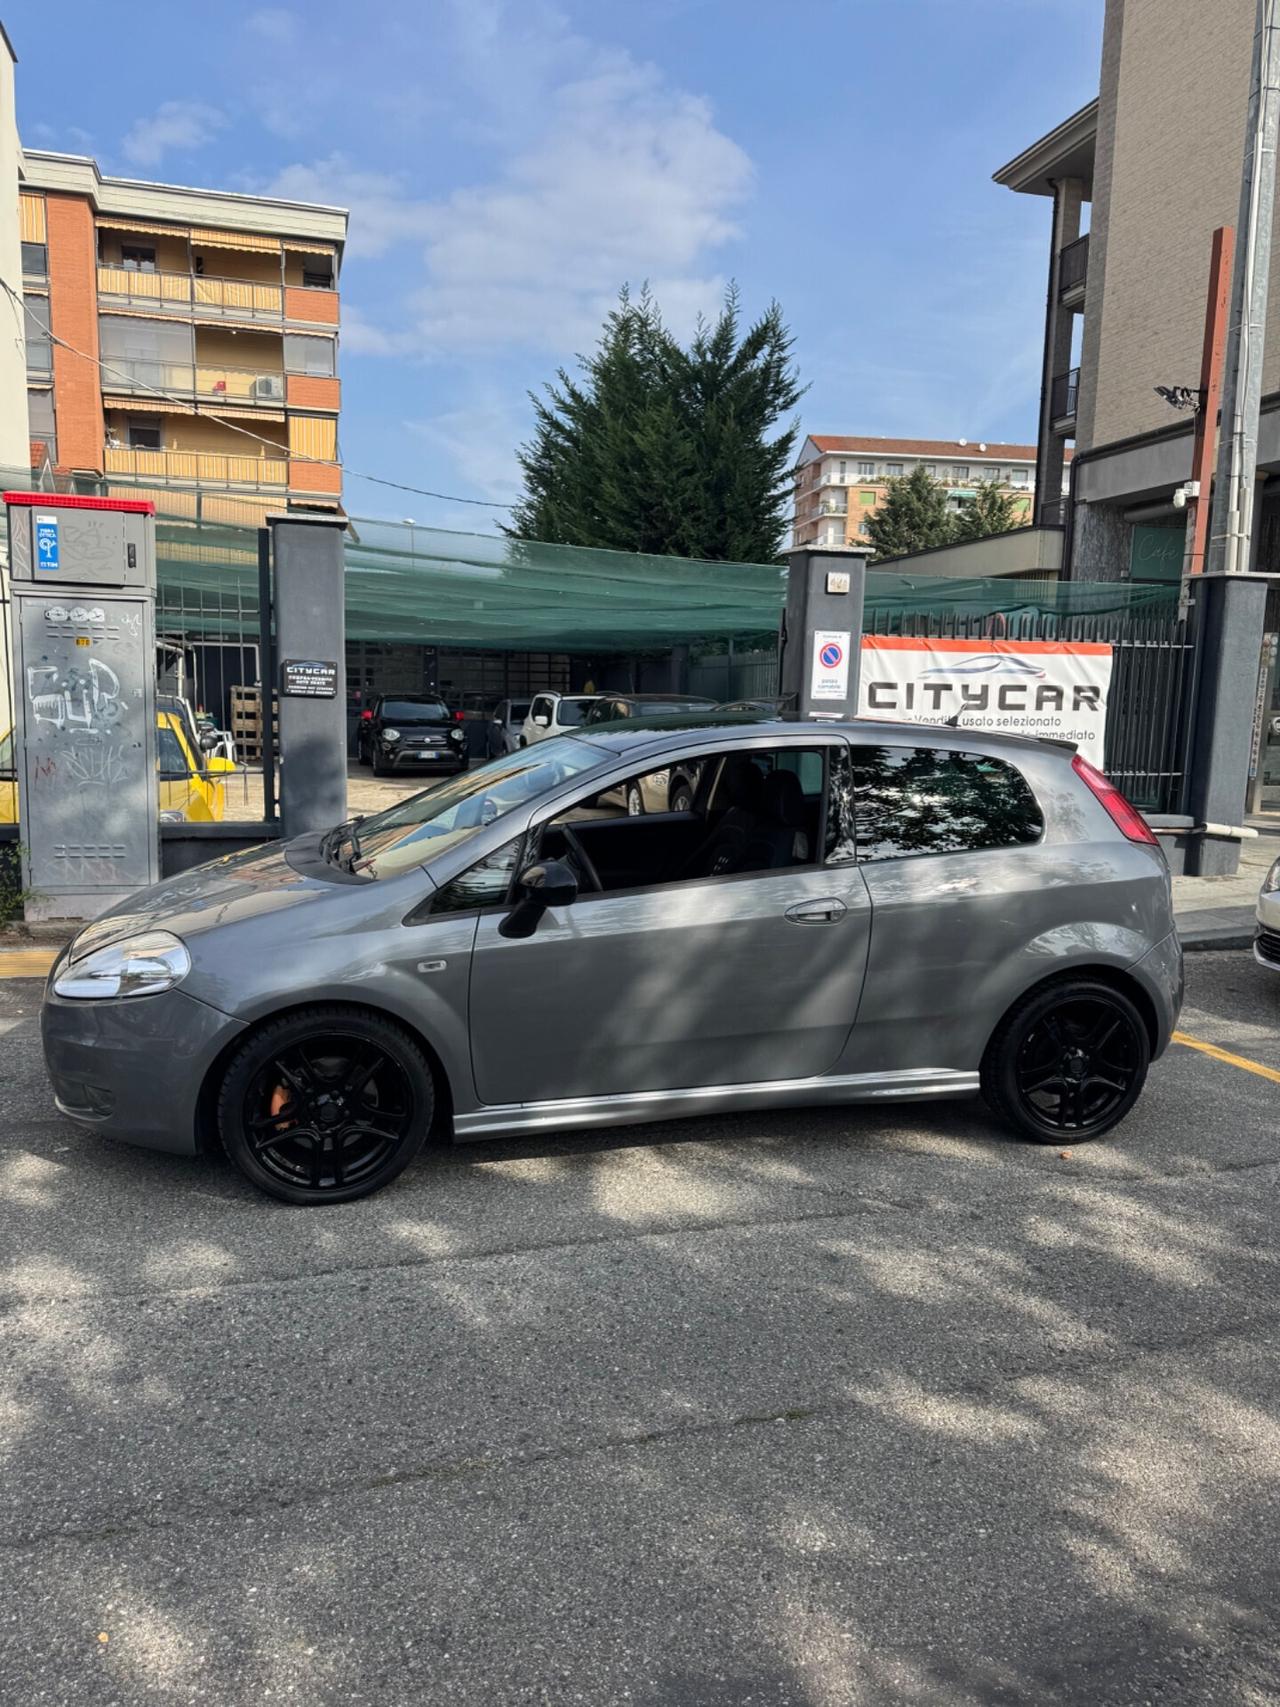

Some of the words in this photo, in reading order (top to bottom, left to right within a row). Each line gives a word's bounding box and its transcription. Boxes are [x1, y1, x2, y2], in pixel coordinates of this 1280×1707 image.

[286, 667, 336, 676] CITYCAR
[867, 682, 1101, 712] CITYCAR
[962, 715, 993, 727] usato
[996, 715, 1062, 727] selezionato
